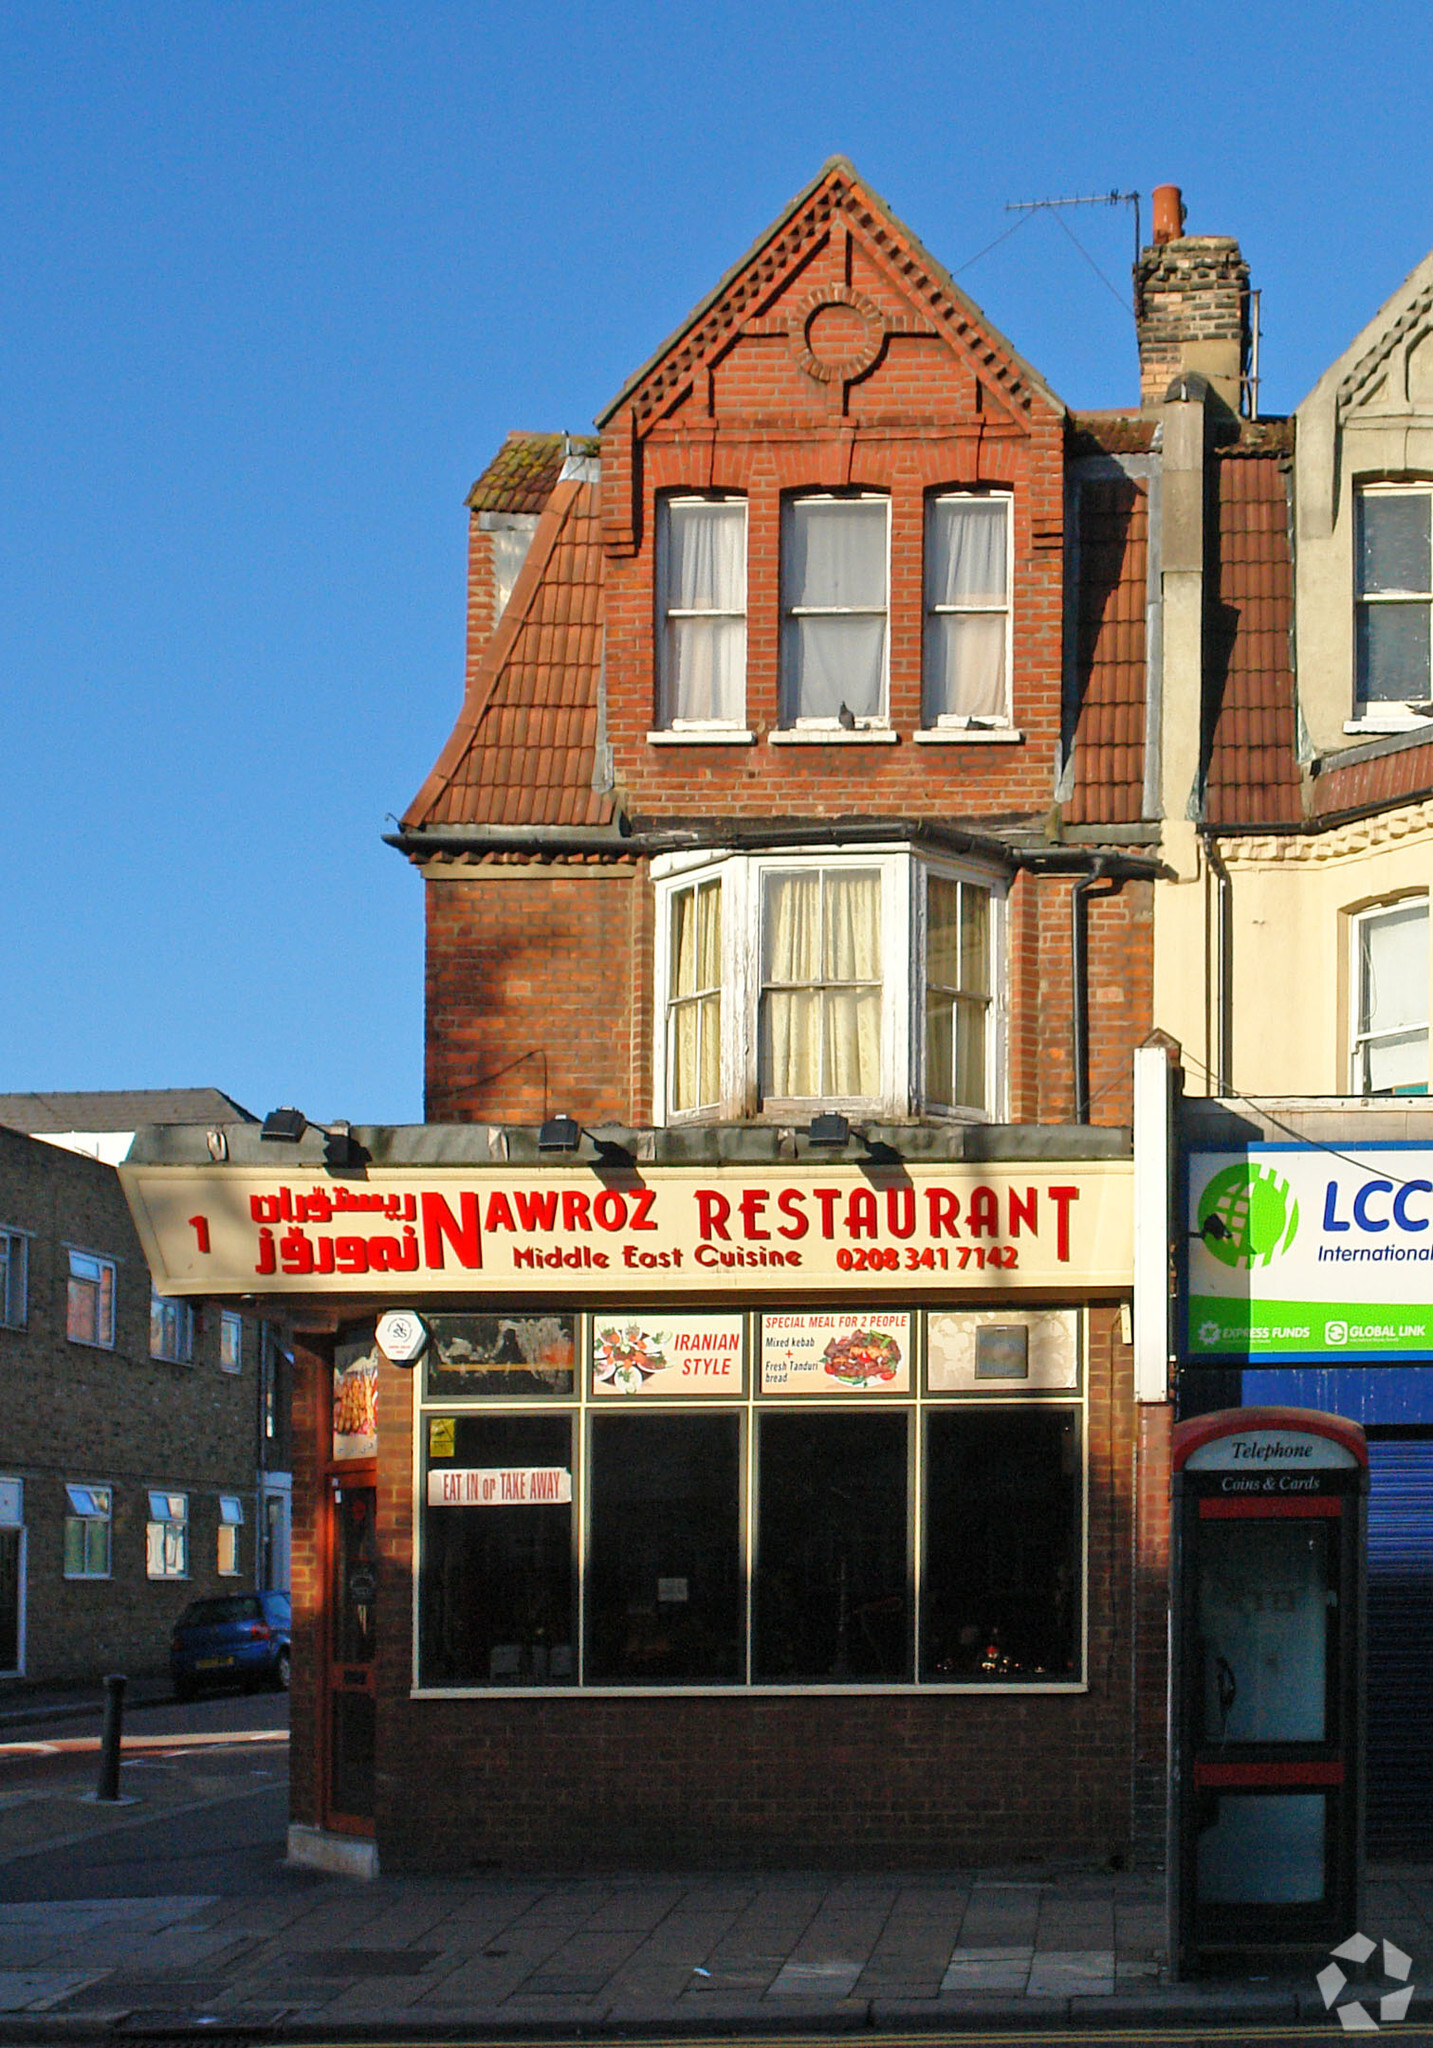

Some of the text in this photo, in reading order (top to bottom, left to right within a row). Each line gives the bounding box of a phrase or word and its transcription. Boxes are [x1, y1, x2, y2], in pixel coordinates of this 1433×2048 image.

[1322, 1179, 1433, 1232] LCC
[187, 1214, 212, 1254] 1
[421, 1186, 1080, 1270] NAWROZ RESTAURANT
[512, 1243, 803, 1269] Middle East Cuisine
[836, 1245, 1020, 1272] 0208 341 7142
[765, 1315, 907, 1329] SPECIAL MEAL FOR 2 PEOPLE
[1349, 1325, 1426, 1338] GLOBAL LINK
[674, 1333, 740, 1352] IRANIAN
[765, 1336, 815, 1348] Mixed kebab
[1272, 1327, 1310, 1339] FUNDS
[682, 1357, 731, 1377] STYLE
[765, 1360, 818, 1372] Fresh Tanduri
[765, 1373, 788, 1383] bread
[1232, 1442, 1313, 1461] Telephone
[443, 1473, 462, 1501] EAT
[466, 1473, 478, 1500] IN
[500, 1472, 526, 1500] TAKE
[530, 1472, 560, 1499] AWAY
[1221, 1475, 1320, 1492] Coins & Cards
